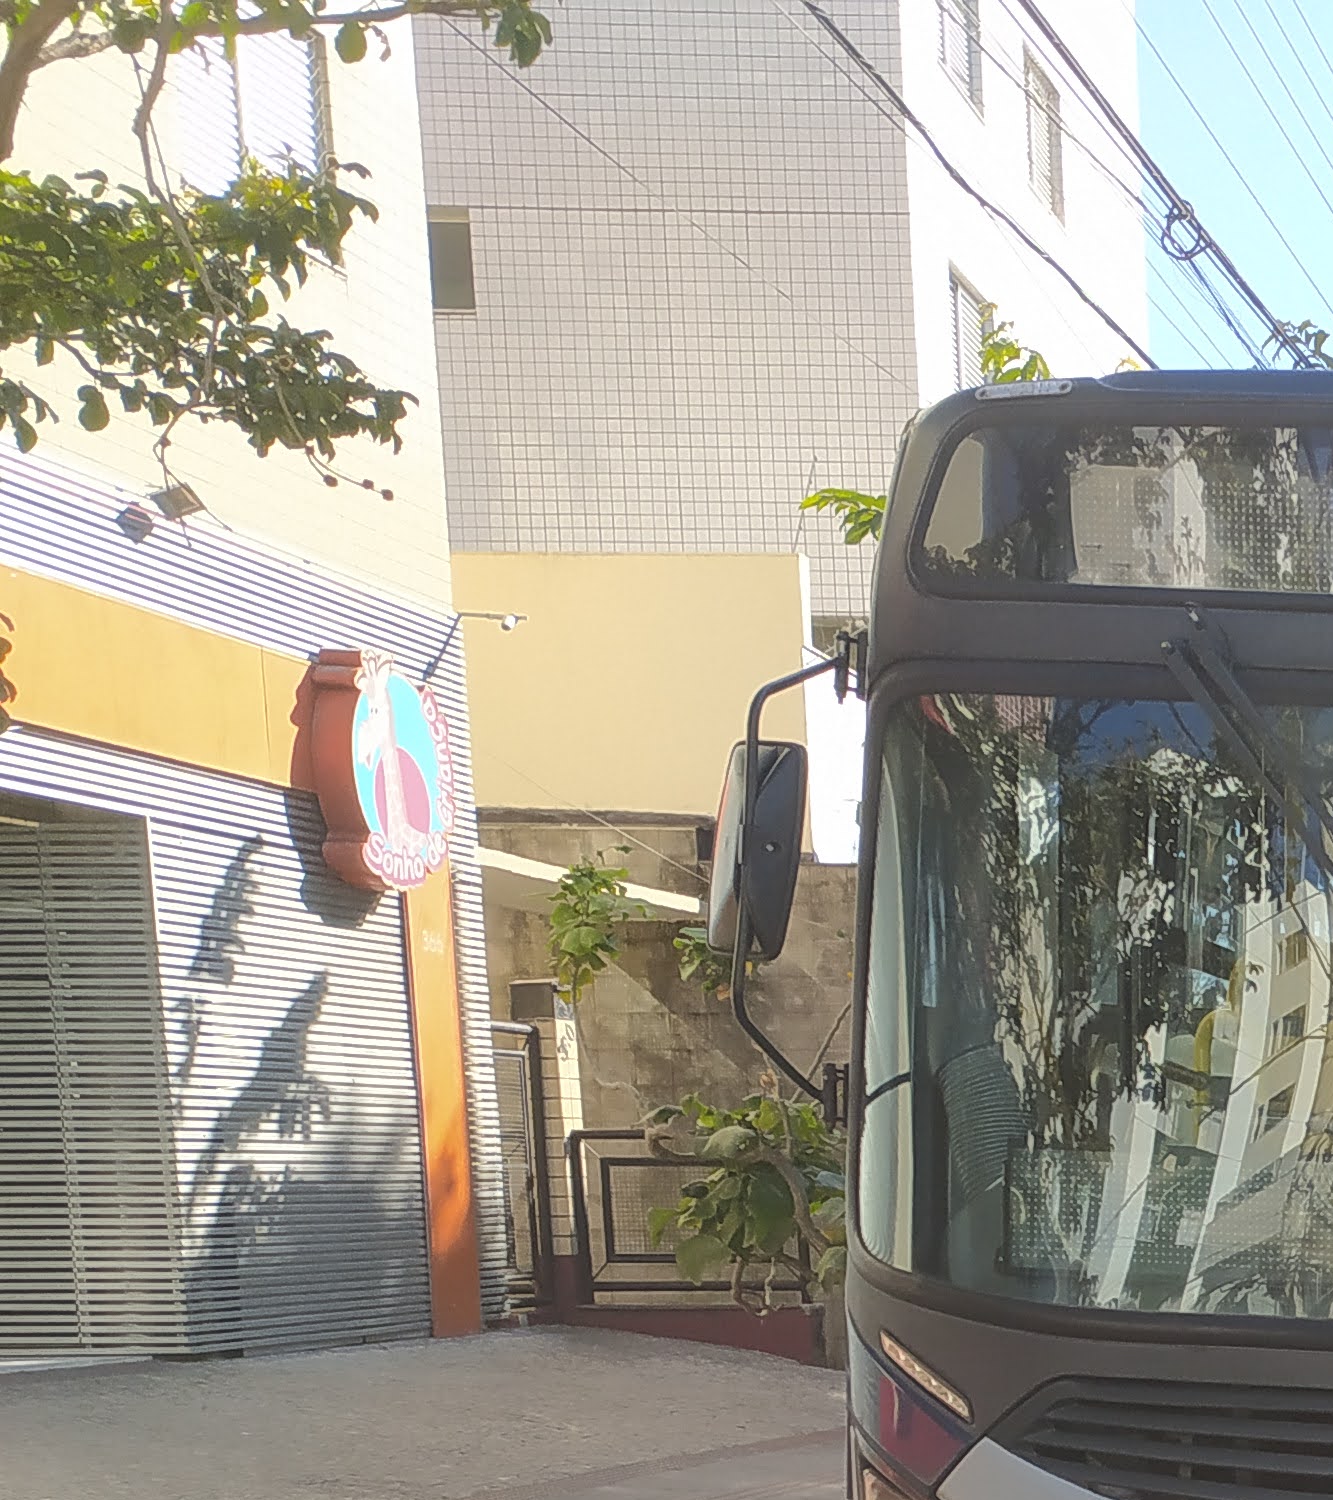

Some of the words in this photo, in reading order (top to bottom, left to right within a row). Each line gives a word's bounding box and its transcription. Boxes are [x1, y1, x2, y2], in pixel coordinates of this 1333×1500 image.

[422, 694, 454, 828] Criança
[367, 833, 425, 881] Sonho
[427, 833, 447, 867] de
